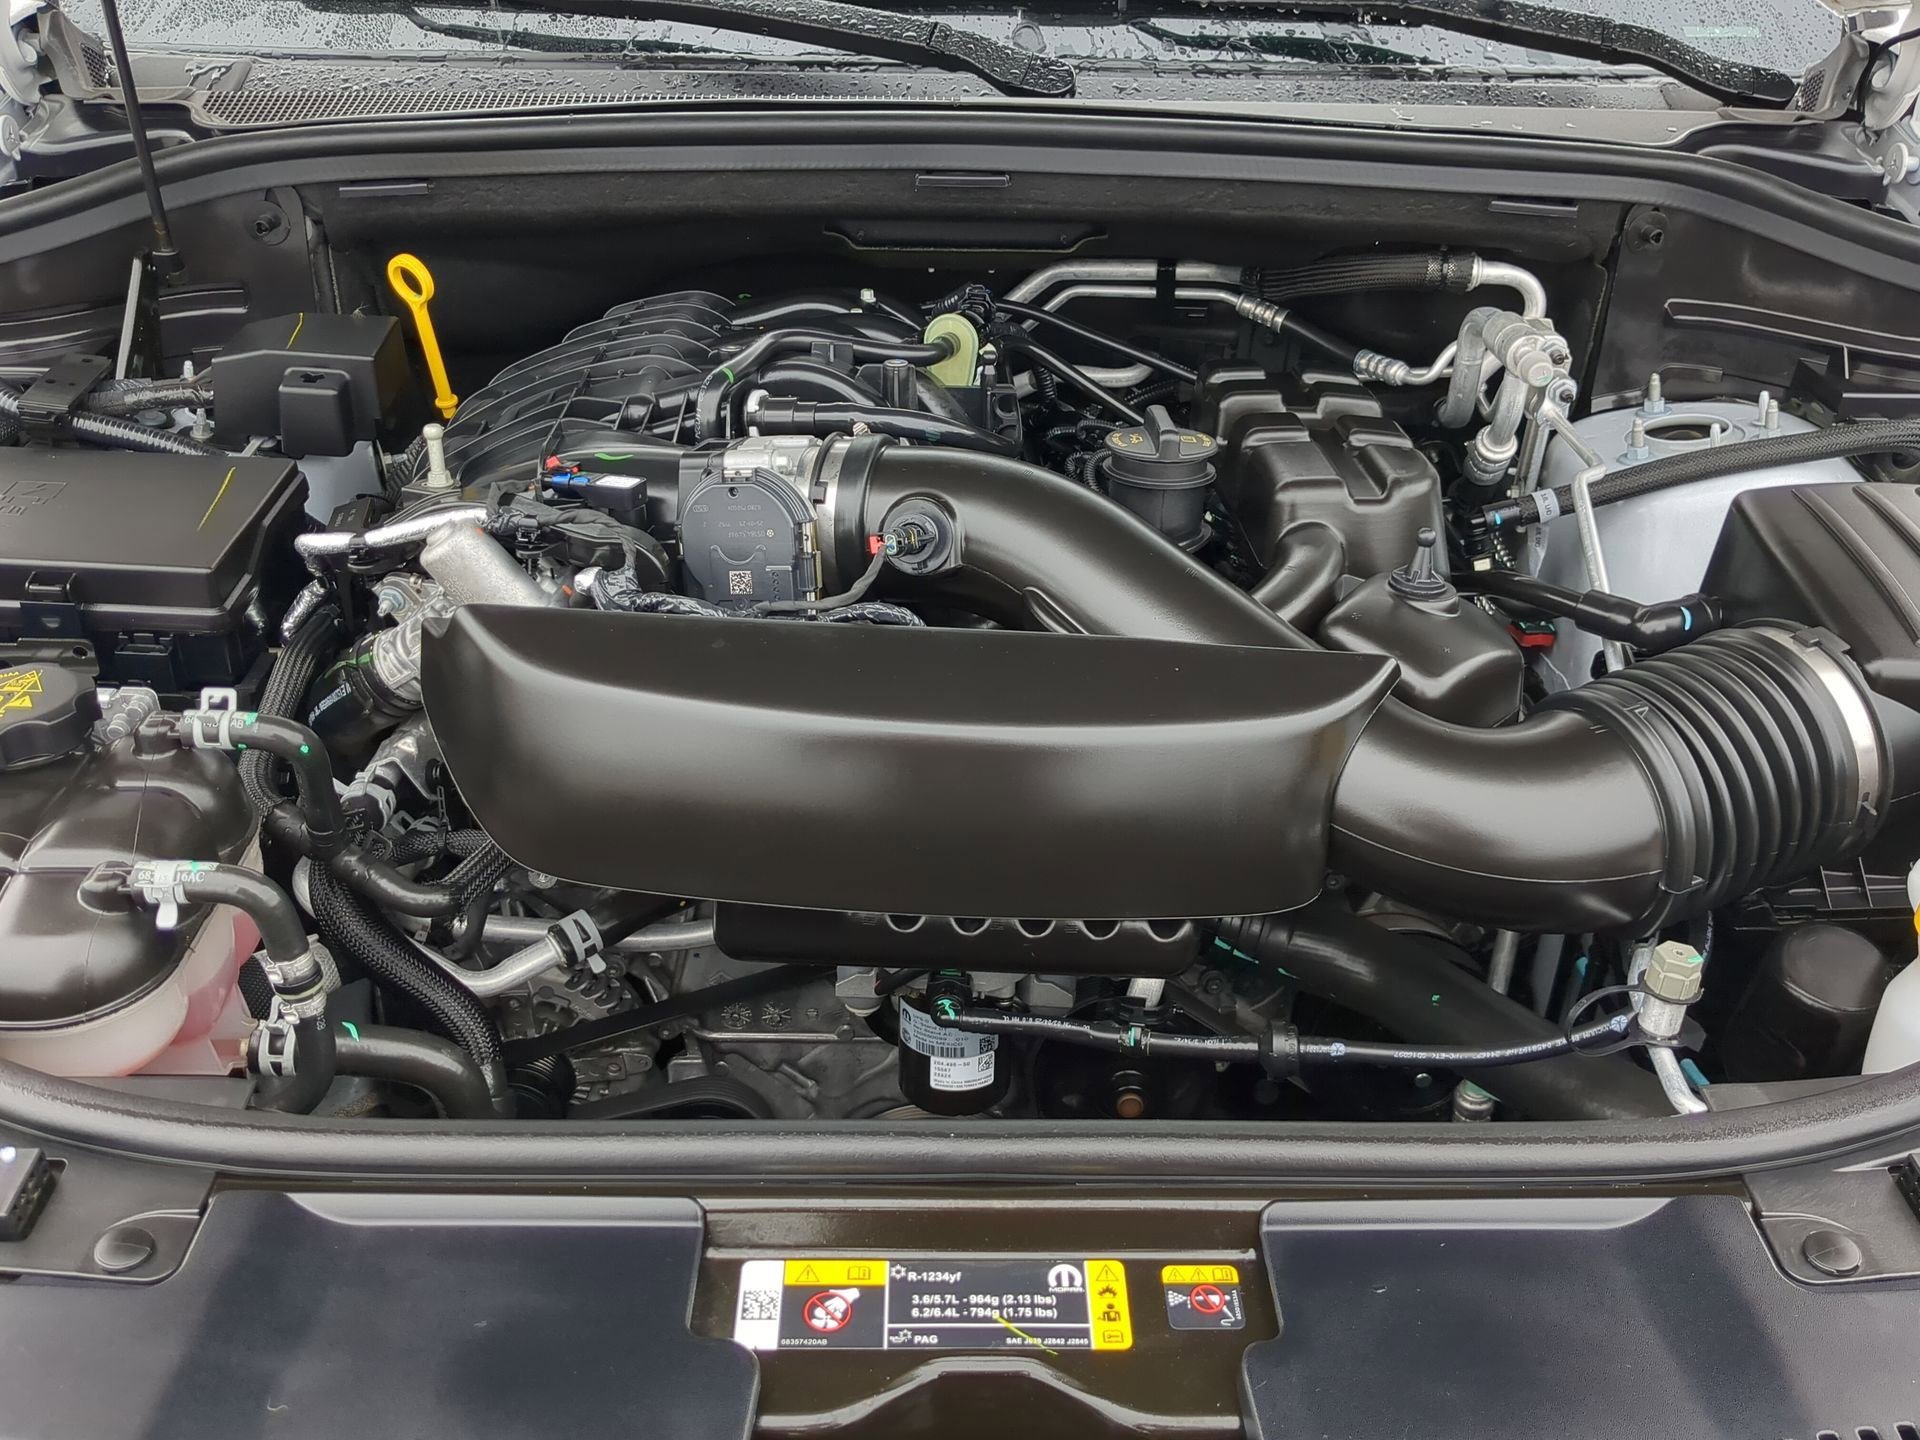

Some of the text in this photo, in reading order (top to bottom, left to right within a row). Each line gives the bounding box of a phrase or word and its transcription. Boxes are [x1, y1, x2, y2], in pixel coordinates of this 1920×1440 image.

[907, 1271, 961, 1283] R-1234yf
[912, 1294, 959, 1305] 3.6/5.7L
[969, 1294, 999, 1306] 964g
[1002, 1294, 1031, 1305] (2.13
[1034, 1294, 1057, 1306] lbs)
[911, 1307, 960, 1318] 6.2/6.4L
[969, 1307, 1000, 1319] 794g
[1003, 1307, 1032, 1318] (1.75
[1035, 1307, 1058, 1319] lbs)
[914, 1335, 938, 1344] PAG
[1006, 1337, 1022, 1345] SAE
